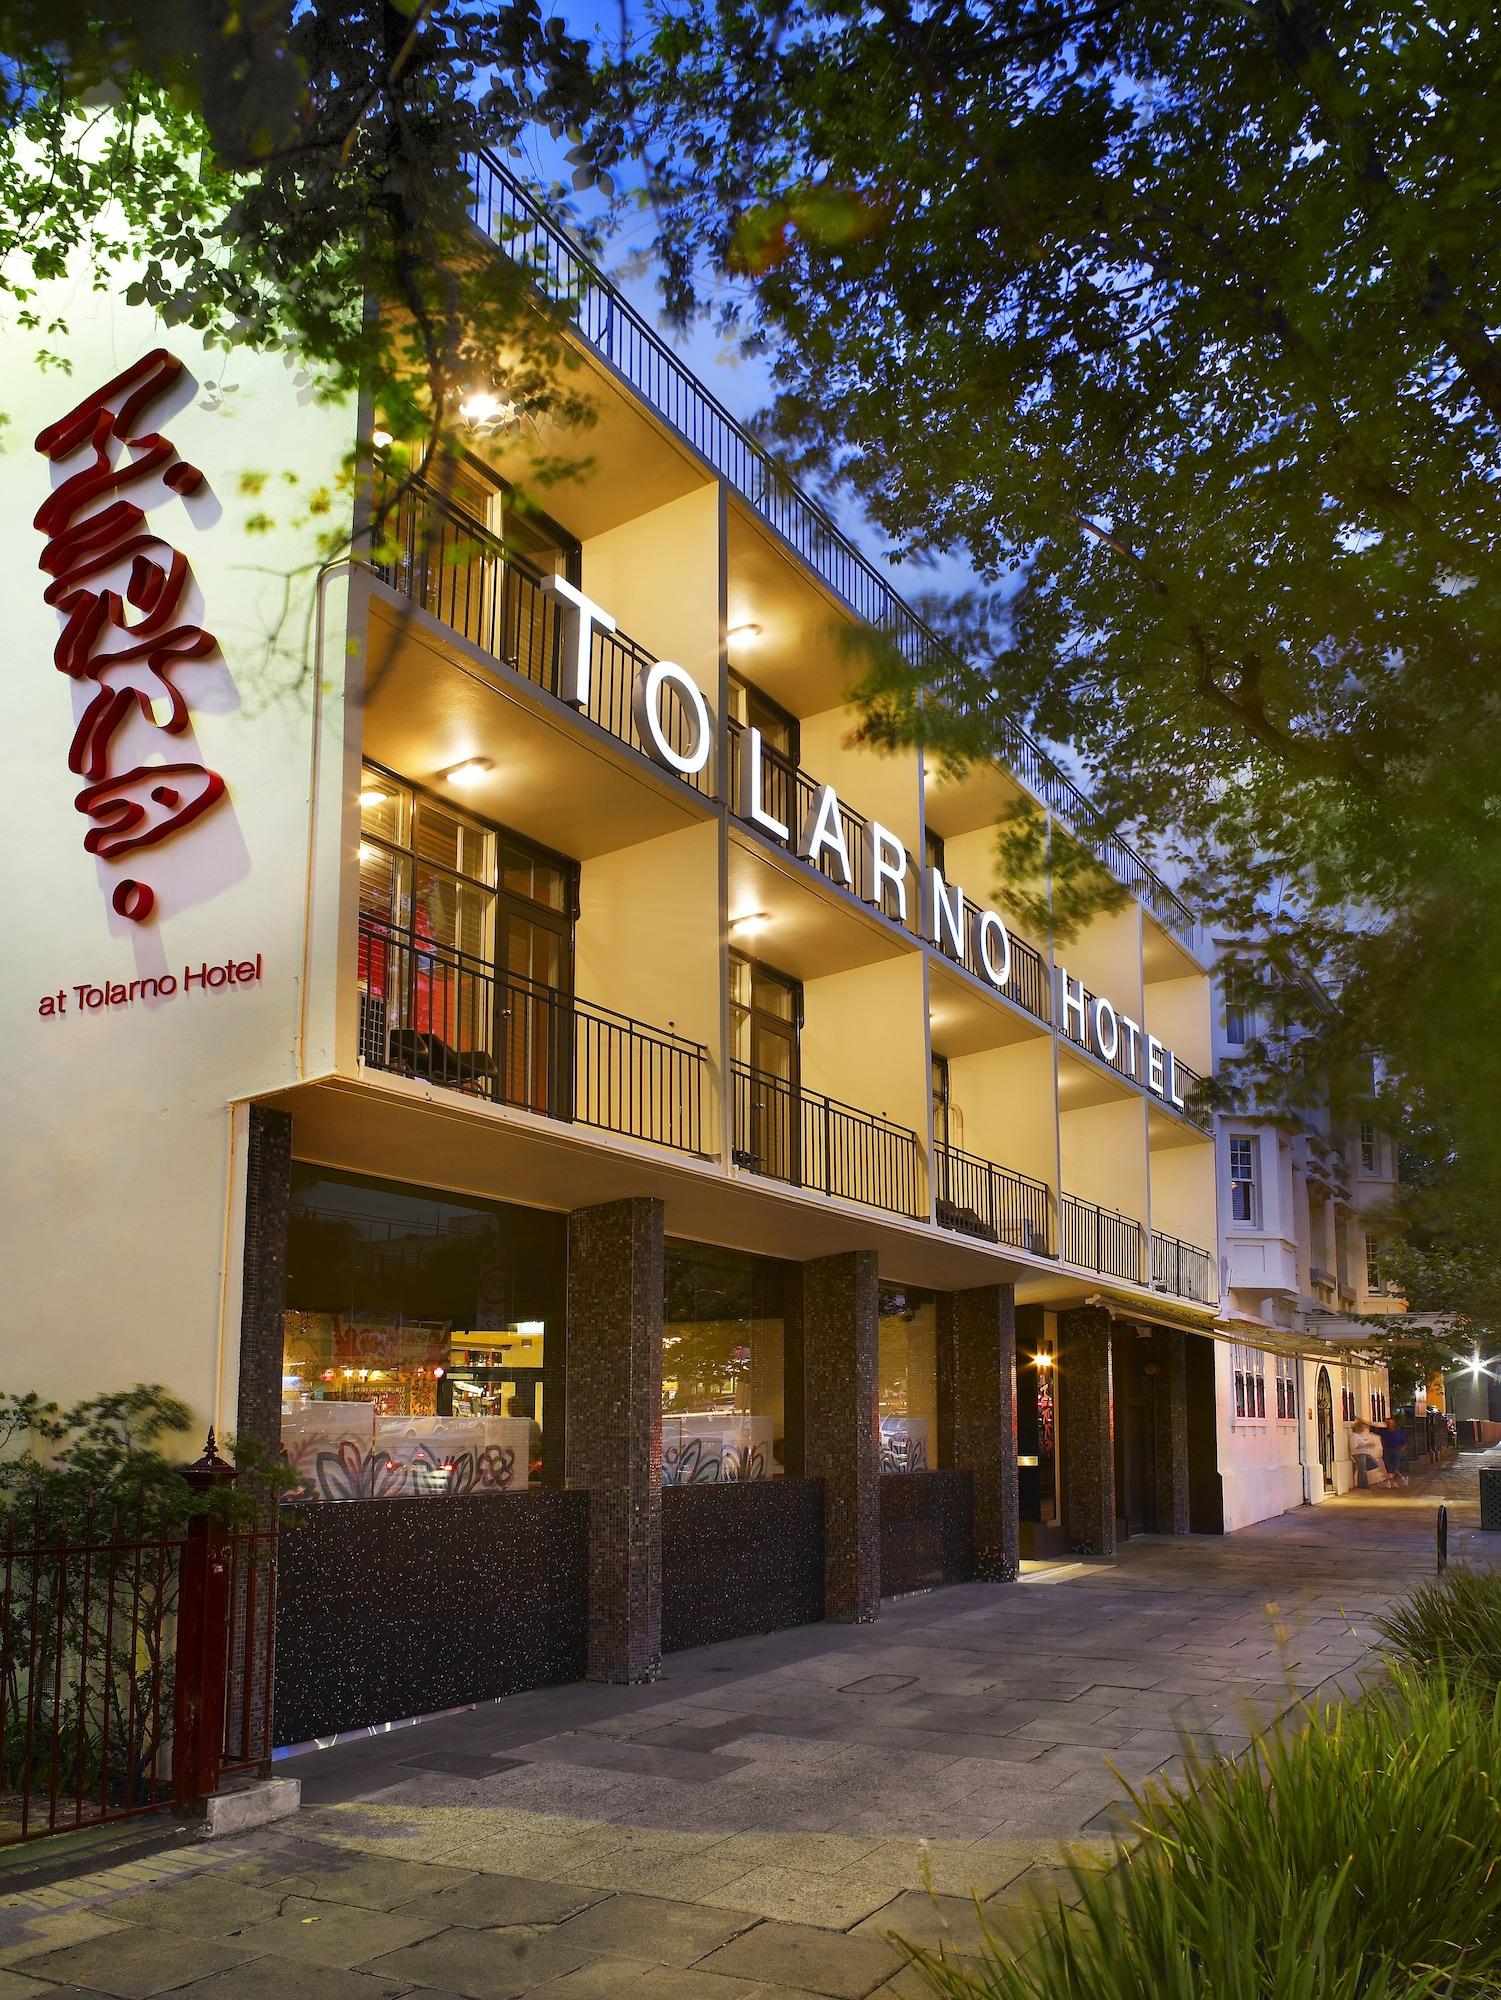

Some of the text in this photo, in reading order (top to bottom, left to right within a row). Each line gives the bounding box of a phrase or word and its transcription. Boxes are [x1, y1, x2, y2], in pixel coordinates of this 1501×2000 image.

[38, 953, 262, 1017] at Tolarno Hotel
[540, 573, 1185, 1108] TOLARNO HOTEL
